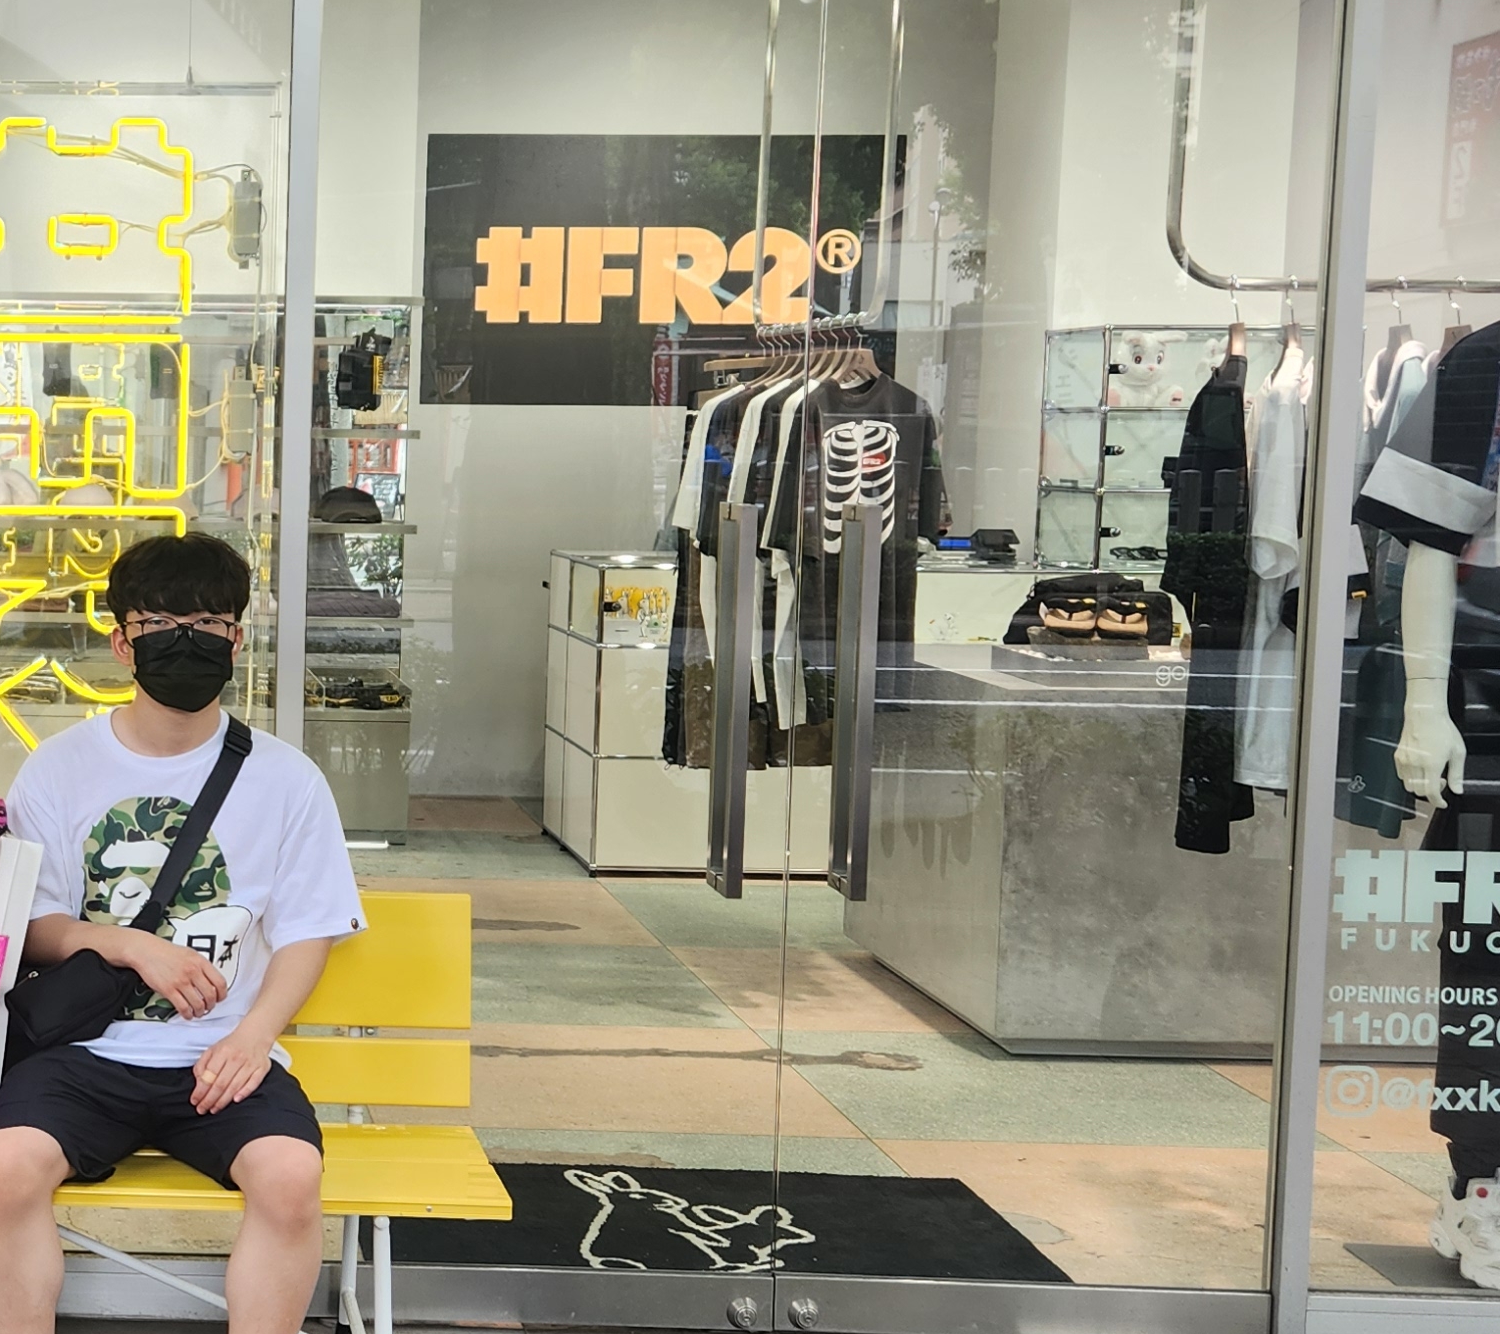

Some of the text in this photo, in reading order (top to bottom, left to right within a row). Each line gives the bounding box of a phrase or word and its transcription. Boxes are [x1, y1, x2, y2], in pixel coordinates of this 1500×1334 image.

[1328, 985, 1498, 1006] OPENING HOURS
[1326, 1010, 1500, 1048] 11:00~2
